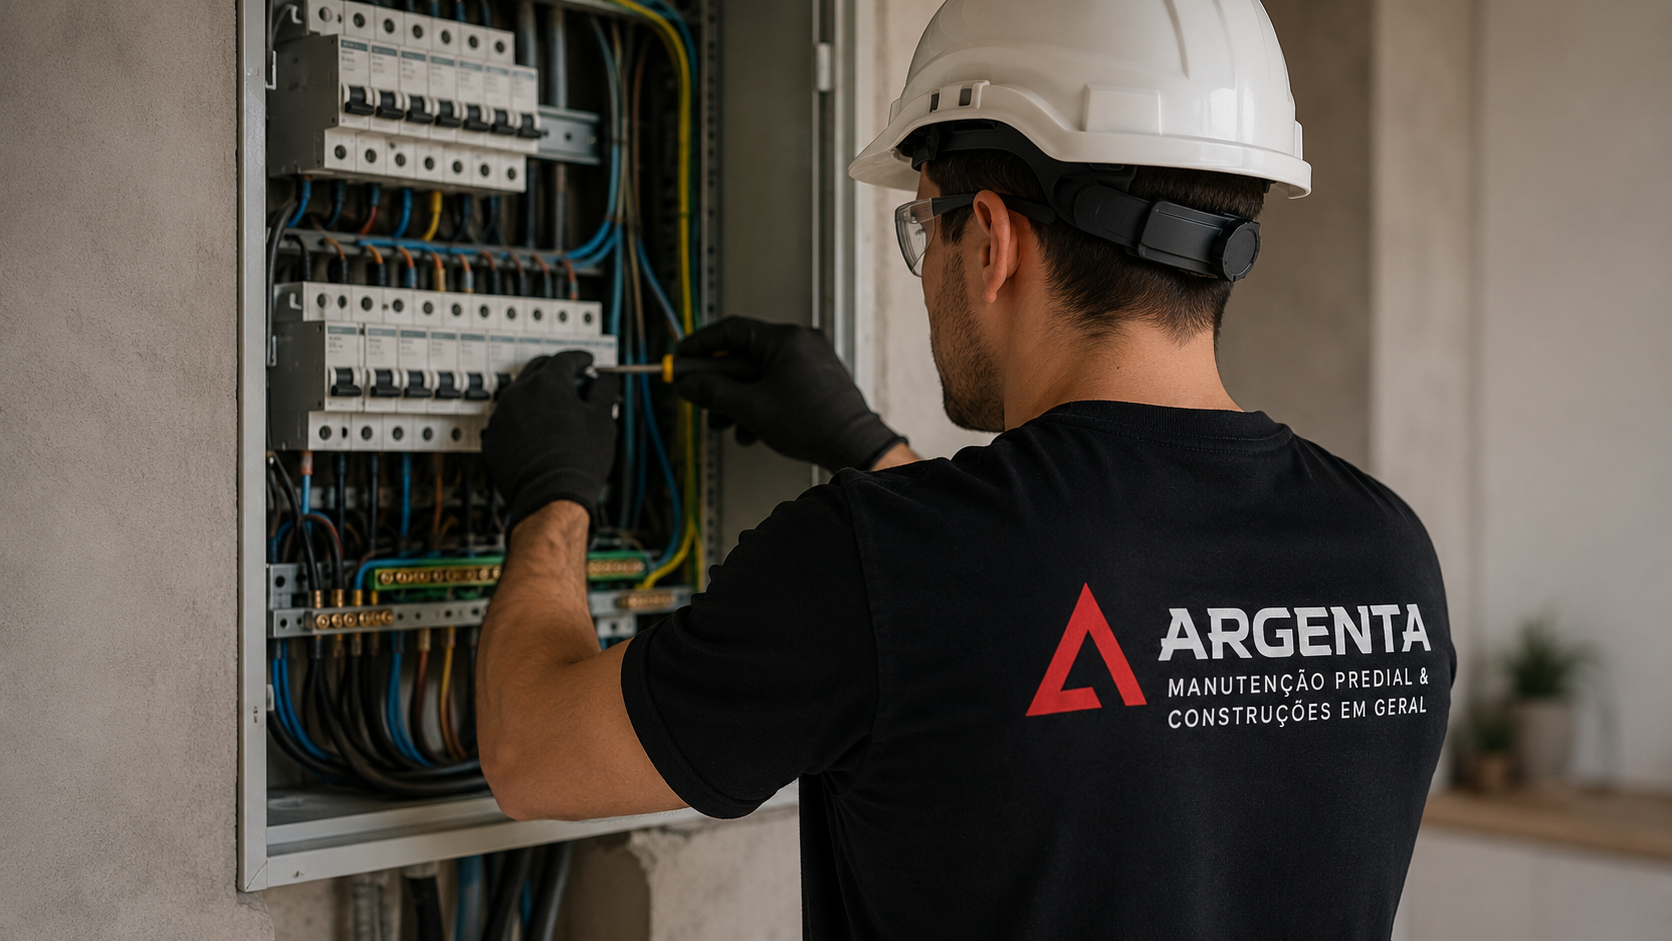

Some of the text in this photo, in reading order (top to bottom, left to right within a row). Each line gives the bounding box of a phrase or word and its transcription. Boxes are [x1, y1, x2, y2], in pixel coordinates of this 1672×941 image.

[1157, 603, 1432, 662] ARGENTA
[1167, 666, 1430, 698] MANUTENÇÃO PREDIAL &
[1167, 695, 1428, 729] CONSTRUÇÕES EM GERAL
